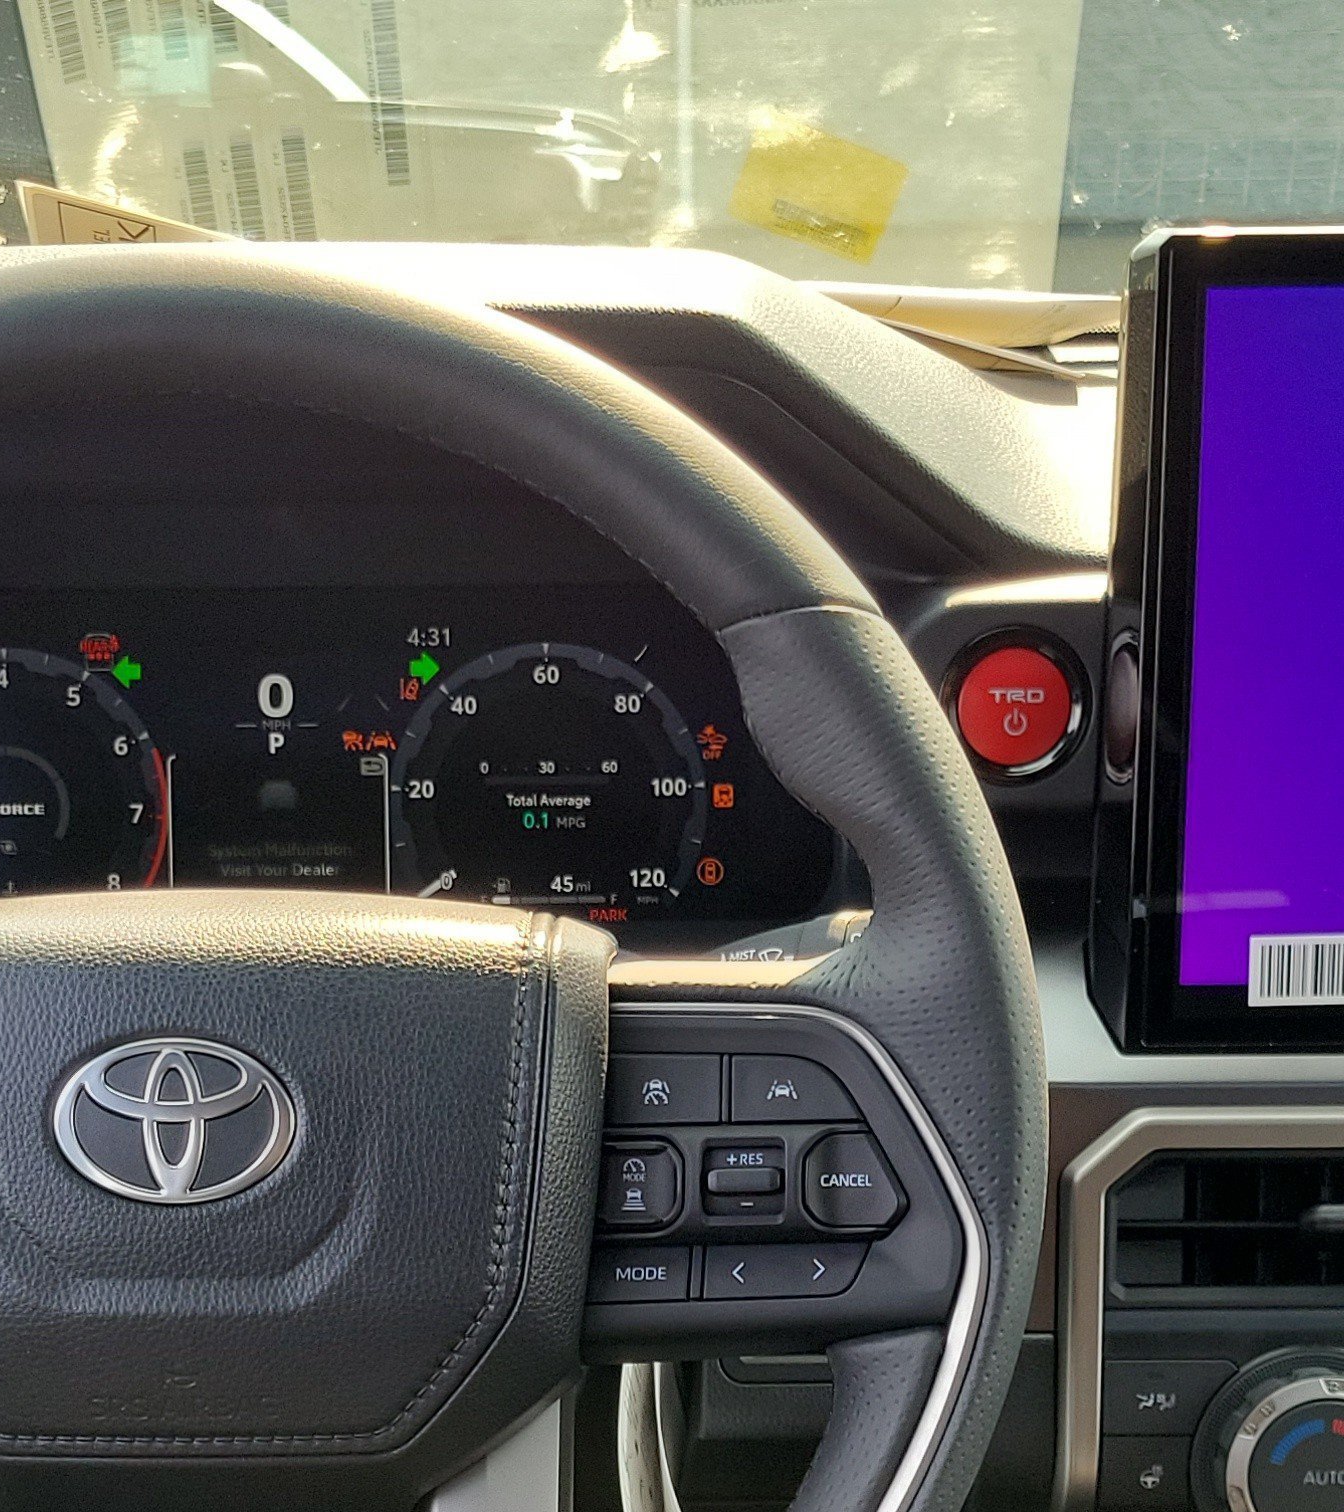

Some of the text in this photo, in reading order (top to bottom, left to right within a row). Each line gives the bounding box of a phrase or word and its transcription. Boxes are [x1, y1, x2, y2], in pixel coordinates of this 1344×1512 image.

[407, 628, 451, 648] 4:31
[533, 666, 560, 685] 60
[66, 687, 82, 707] 5
[257, 673, 296, 719] 0
[988, 687, 1046, 704] TRD
[451, 697, 477, 716] 40
[614, 696, 641, 715] 80
[262, 720, 291, 731] MPH
[113, 737, 128, 756] 6
[268, 732, 285, 755] P
[480, 761, 618, 774] 0 30 60
[408, 781, 435, 799] 20
[651, 778, 688, 797] 100
[506, 794, 592, 810] Total Average
[128, 804, 144, 824] 7
[523, 811, 586, 830] 0.1 MPG
[221, 863, 340, 877] Visit Your Dealer
[629, 869, 666, 888] 120
[107, 874, 122, 891] 8
[550, 876, 591, 893] 45 mi
[589, 909, 628, 922] PARK
[729, 950, 756, 962] MIST
[623, 1172, 646, 1183] MODE
[820, 1173, 872, 1188] CANCEL
[615, 1266, 667, 1281] MODE
